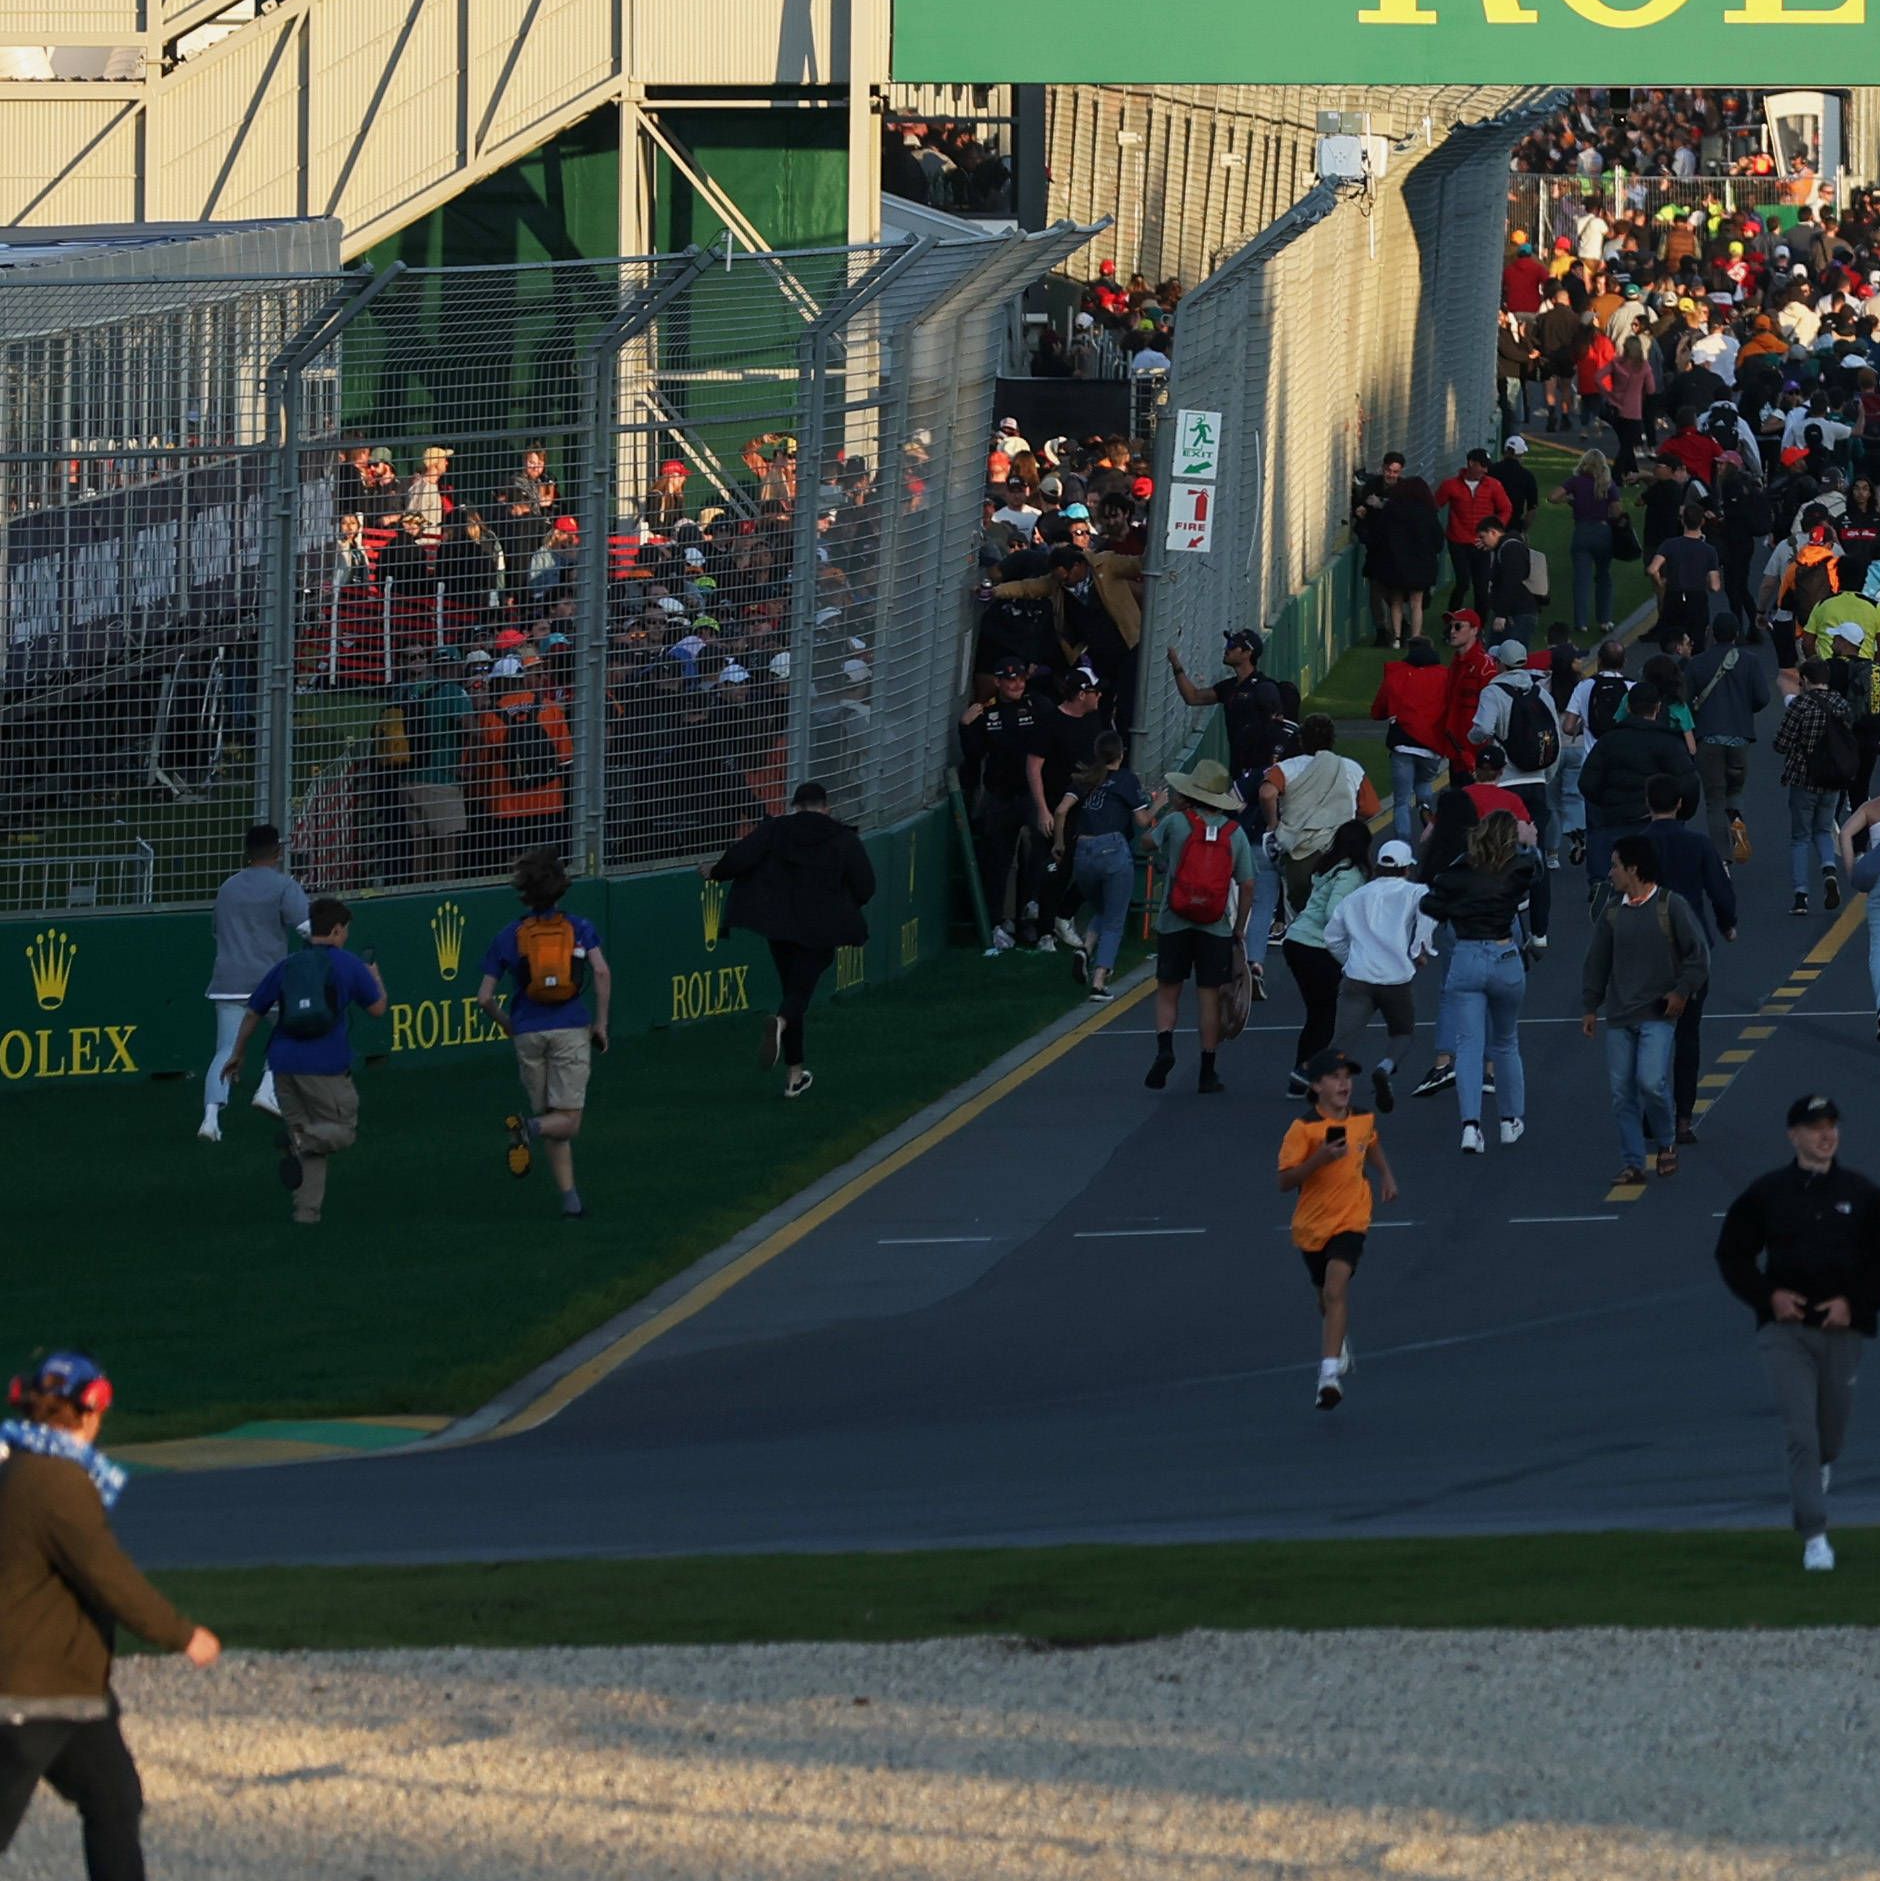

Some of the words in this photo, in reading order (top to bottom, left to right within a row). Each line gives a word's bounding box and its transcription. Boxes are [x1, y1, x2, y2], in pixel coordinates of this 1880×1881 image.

[1182, 449, 1214, 459] EXIT
[1175, 521, 1207, 532] FIRE
[671, 963, 750, 1022] ROLEX
[0, 1024, 140, 1081] OLEX
